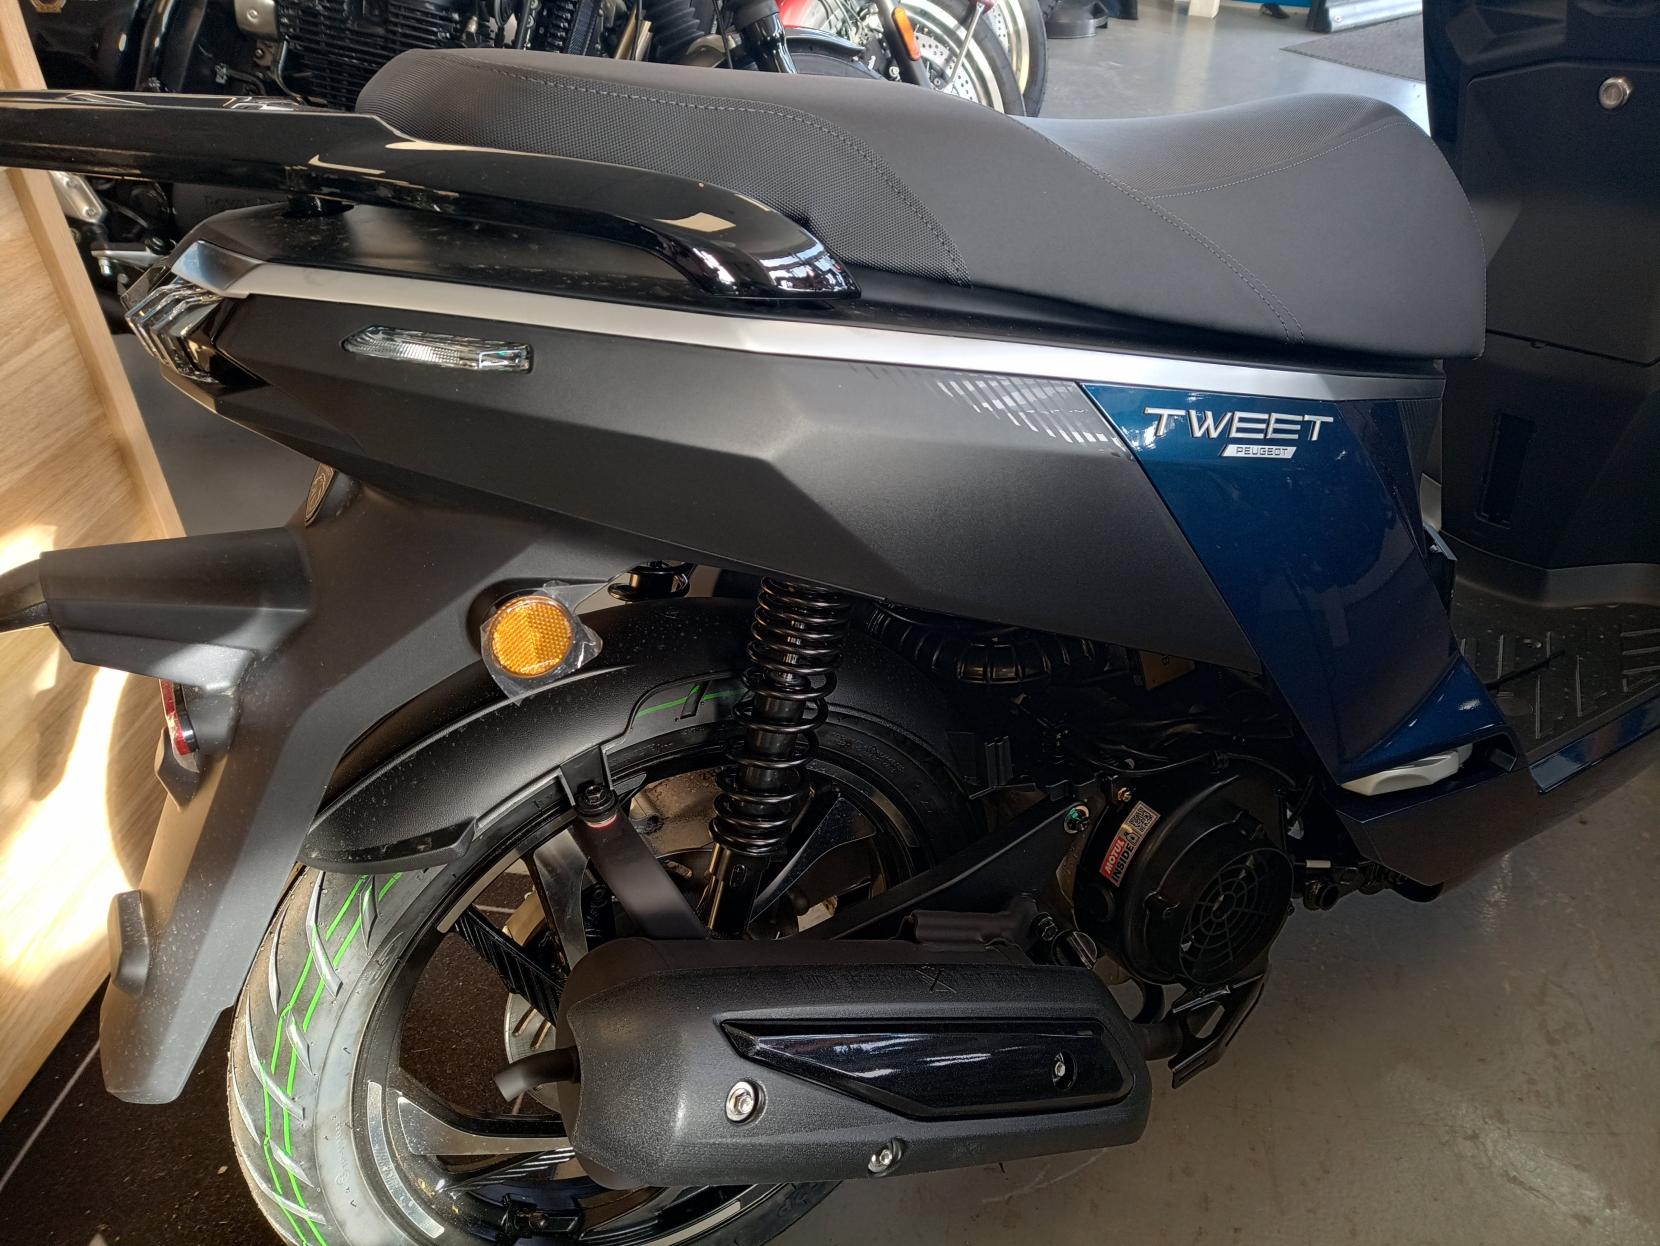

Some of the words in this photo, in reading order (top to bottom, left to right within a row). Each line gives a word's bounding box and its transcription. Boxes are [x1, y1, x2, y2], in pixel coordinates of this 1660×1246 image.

[1144, 406, 1334, 441] TWEET
[1235, 446, 1290, 457] PEUGEOT
[1105, 838, 1126, 875] MOTUL
[1112, 843, 1134, 881] INSIDE
